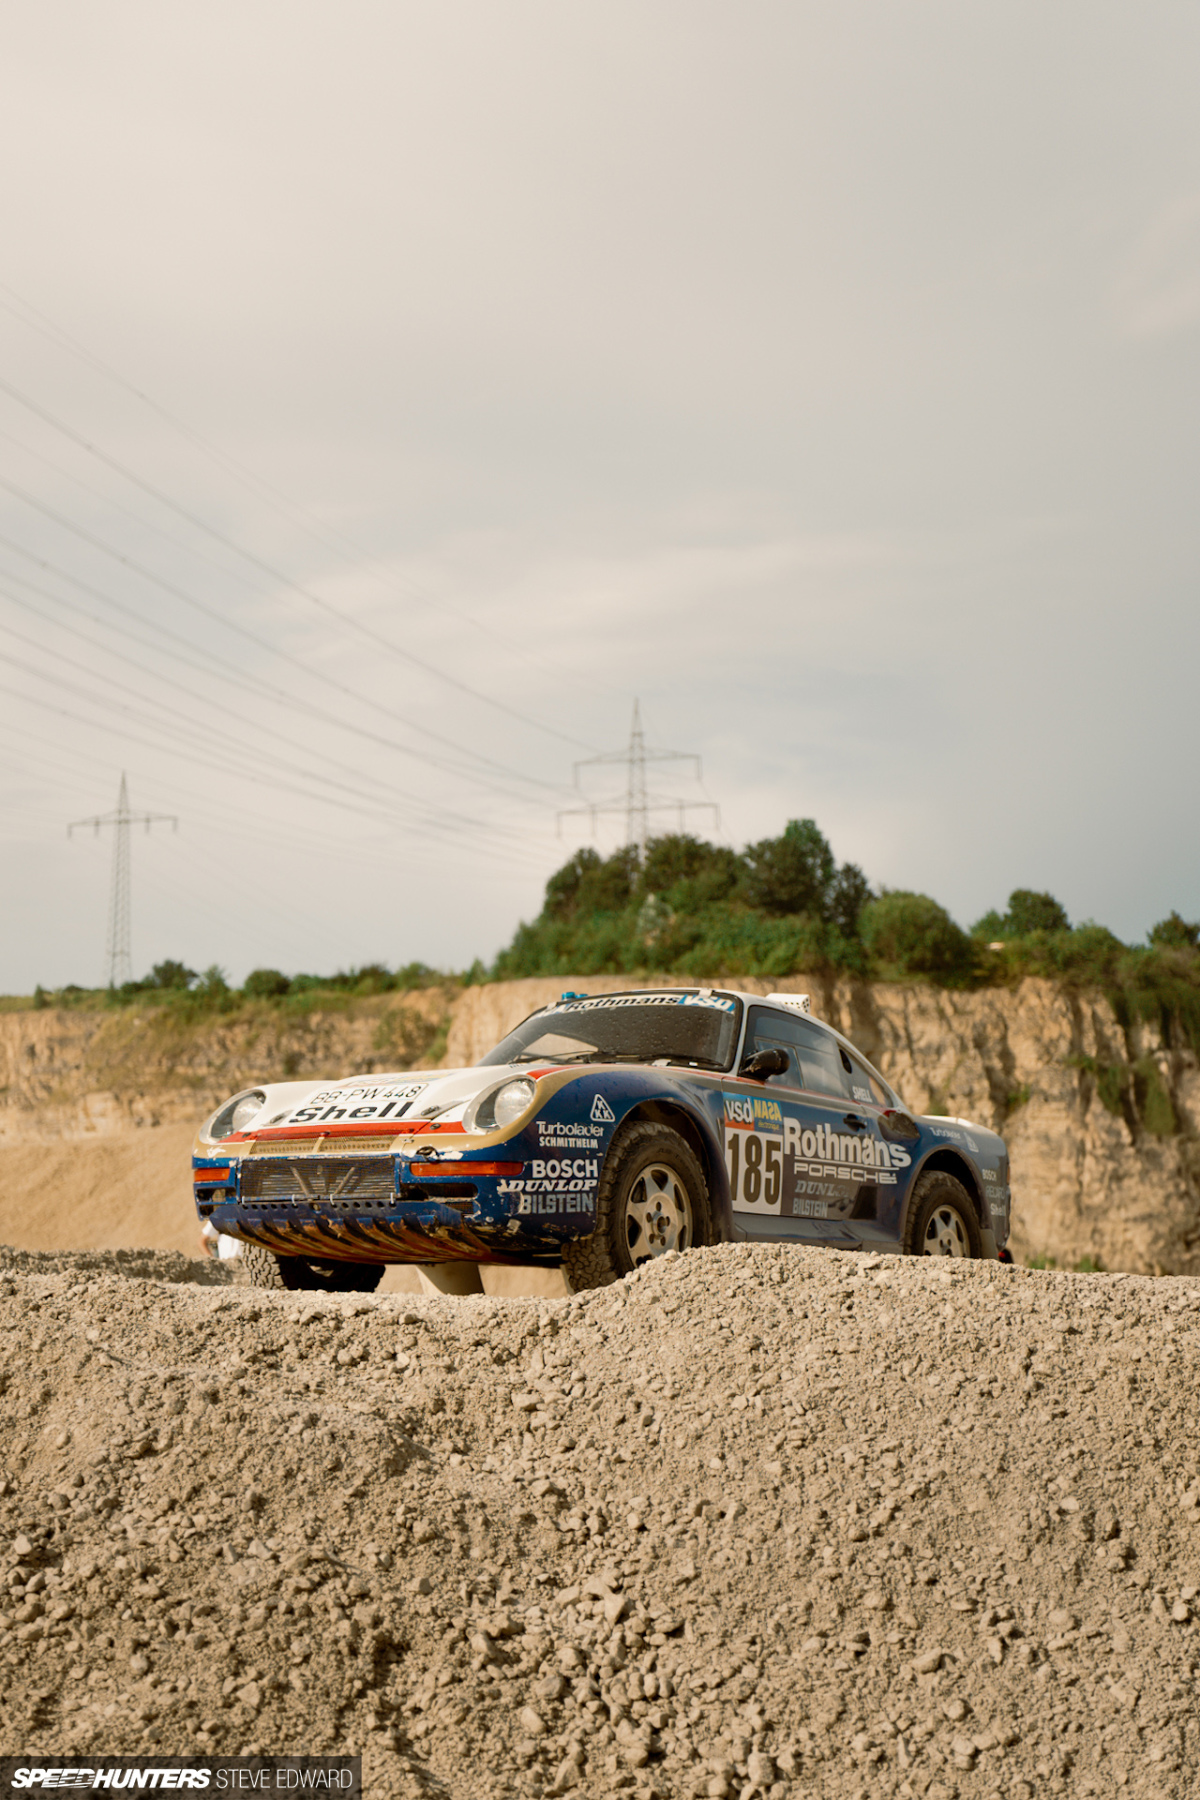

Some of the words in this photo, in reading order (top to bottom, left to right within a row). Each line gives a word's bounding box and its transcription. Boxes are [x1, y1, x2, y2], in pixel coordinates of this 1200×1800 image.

[567, 995, 679, 1012] Rothmans
[288, 1101, 415, 1123] Shell
[783, 1116, 912, 1168] Rothmans
[532, 1159, 599, 1178] BOSCH
[727, 1133, 781, 1205] 185
[794, 1162, 898, 1185] PORSCHE
[507, 1179, 598, 1192] DUNLOP
[519, 1193, 595, 1214] BILSTEIN
[792, 1197, 829, 1218] BILSTEIN
